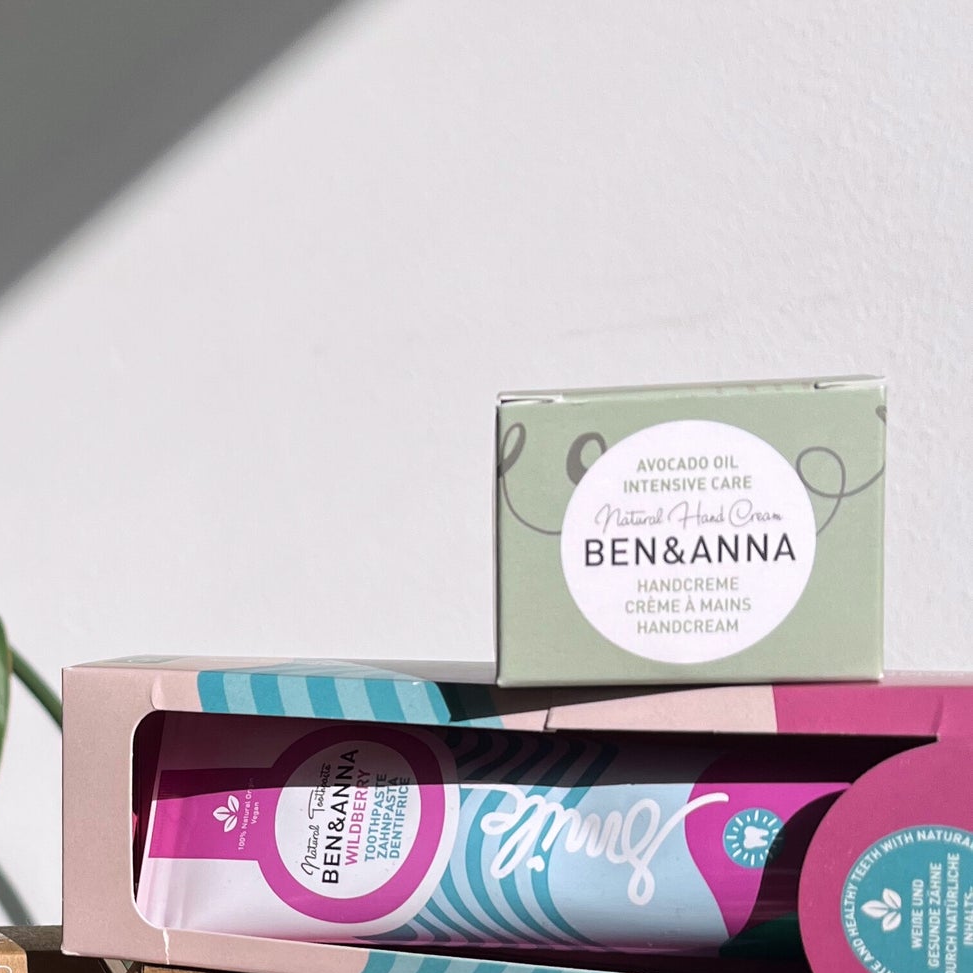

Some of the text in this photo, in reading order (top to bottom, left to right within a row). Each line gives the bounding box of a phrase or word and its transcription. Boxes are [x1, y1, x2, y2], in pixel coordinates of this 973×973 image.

[636, 455, 739, 473] AVOCADO OIL
[623, 476, 753, 494] INTENSIVE CARE
[594, 498, 783, 534] Natural Hand Cream
[584, 532, 796, 567] BEN&ANNA
[637, 577, 739, 593] HANDCREME
[625, 595, 752, 614] CRÈME À MAINS
[637, 619, 739, 635] HANDCREAM
[241, 801, 251, 829] Natural
[251, 801, 260, 824] Vegan
[322, 749, 359, 884] BEN&ANNA
[344, 769, 371, 866] WILDBERRY
[364, 773, 388, 862] TOOTHPASTE
[377, 776, 399, 859] ZAHNPASTA
[389, 776, 410, 859] DENTIFRICE
[238, 831, 247, 851] 100%
[301, 824, 320, 876] Natural
[882, 831, 914, 853] WITH
[916, 828, 973, 850] NATURA
[851, 849, 883, 883] TEETH
[912, 879, 924, 907] UND
[944, 852, 960, 933] NATÜRLICHE
[843, 884, 860, 938] HEALTHY
[926, 862, 942, 968] GESUNDE ZÄHNE
[852, 937, 875, 963] AND
